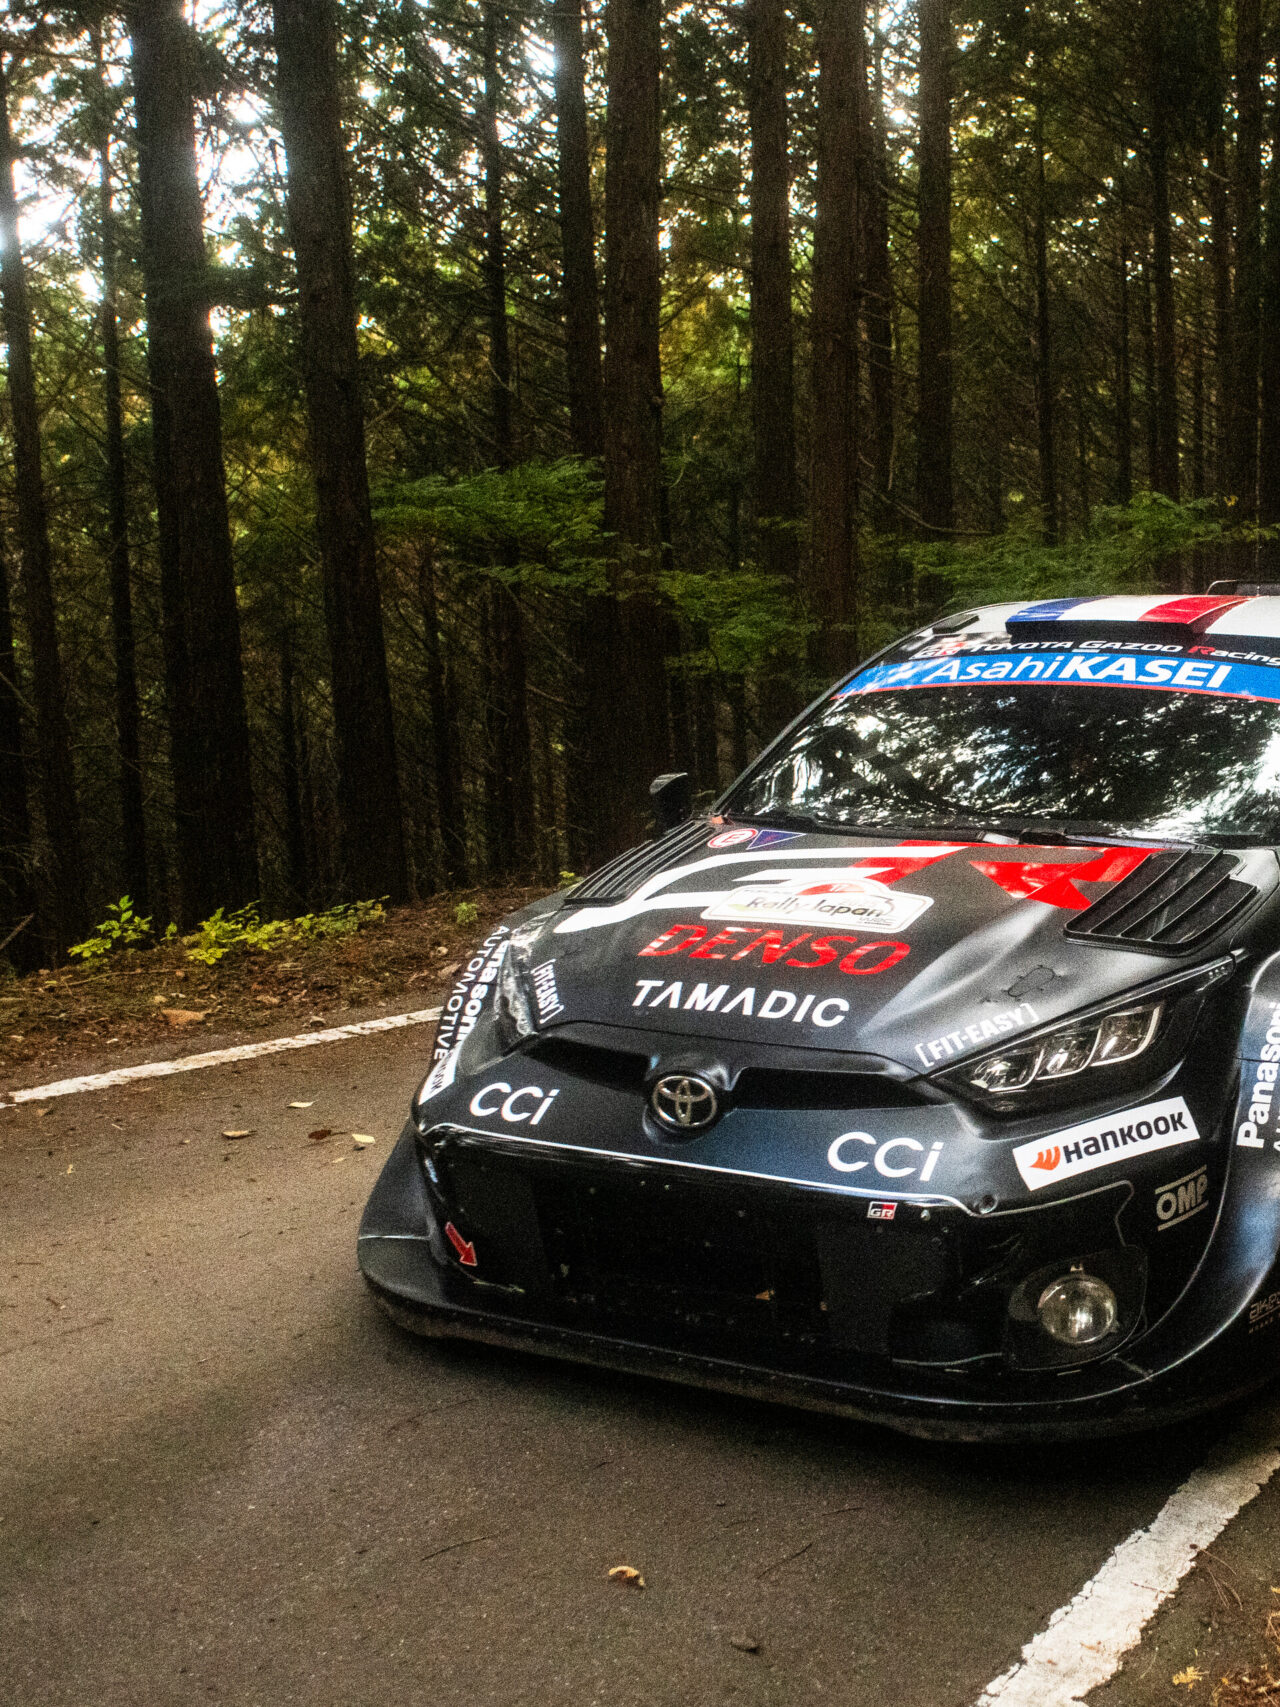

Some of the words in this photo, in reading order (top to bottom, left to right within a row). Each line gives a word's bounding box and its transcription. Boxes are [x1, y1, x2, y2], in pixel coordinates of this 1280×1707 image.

[971, 641, 1075, 652] TOYOTA
[1078, 640, 1184, 653] GAZOO
[921, 655, 1233, 688] AsahiKASEI
[745, 896, 808, 914] Rally
[811, 898, 884, 917] Japan
[638, 924, 911, 975] DENSO
[434, 925, 509, 1060] AUTOMOTIVE
[631, 980, 850, 1027] TAMADIC
[1156, 1174, 1208, 1220] OMP
